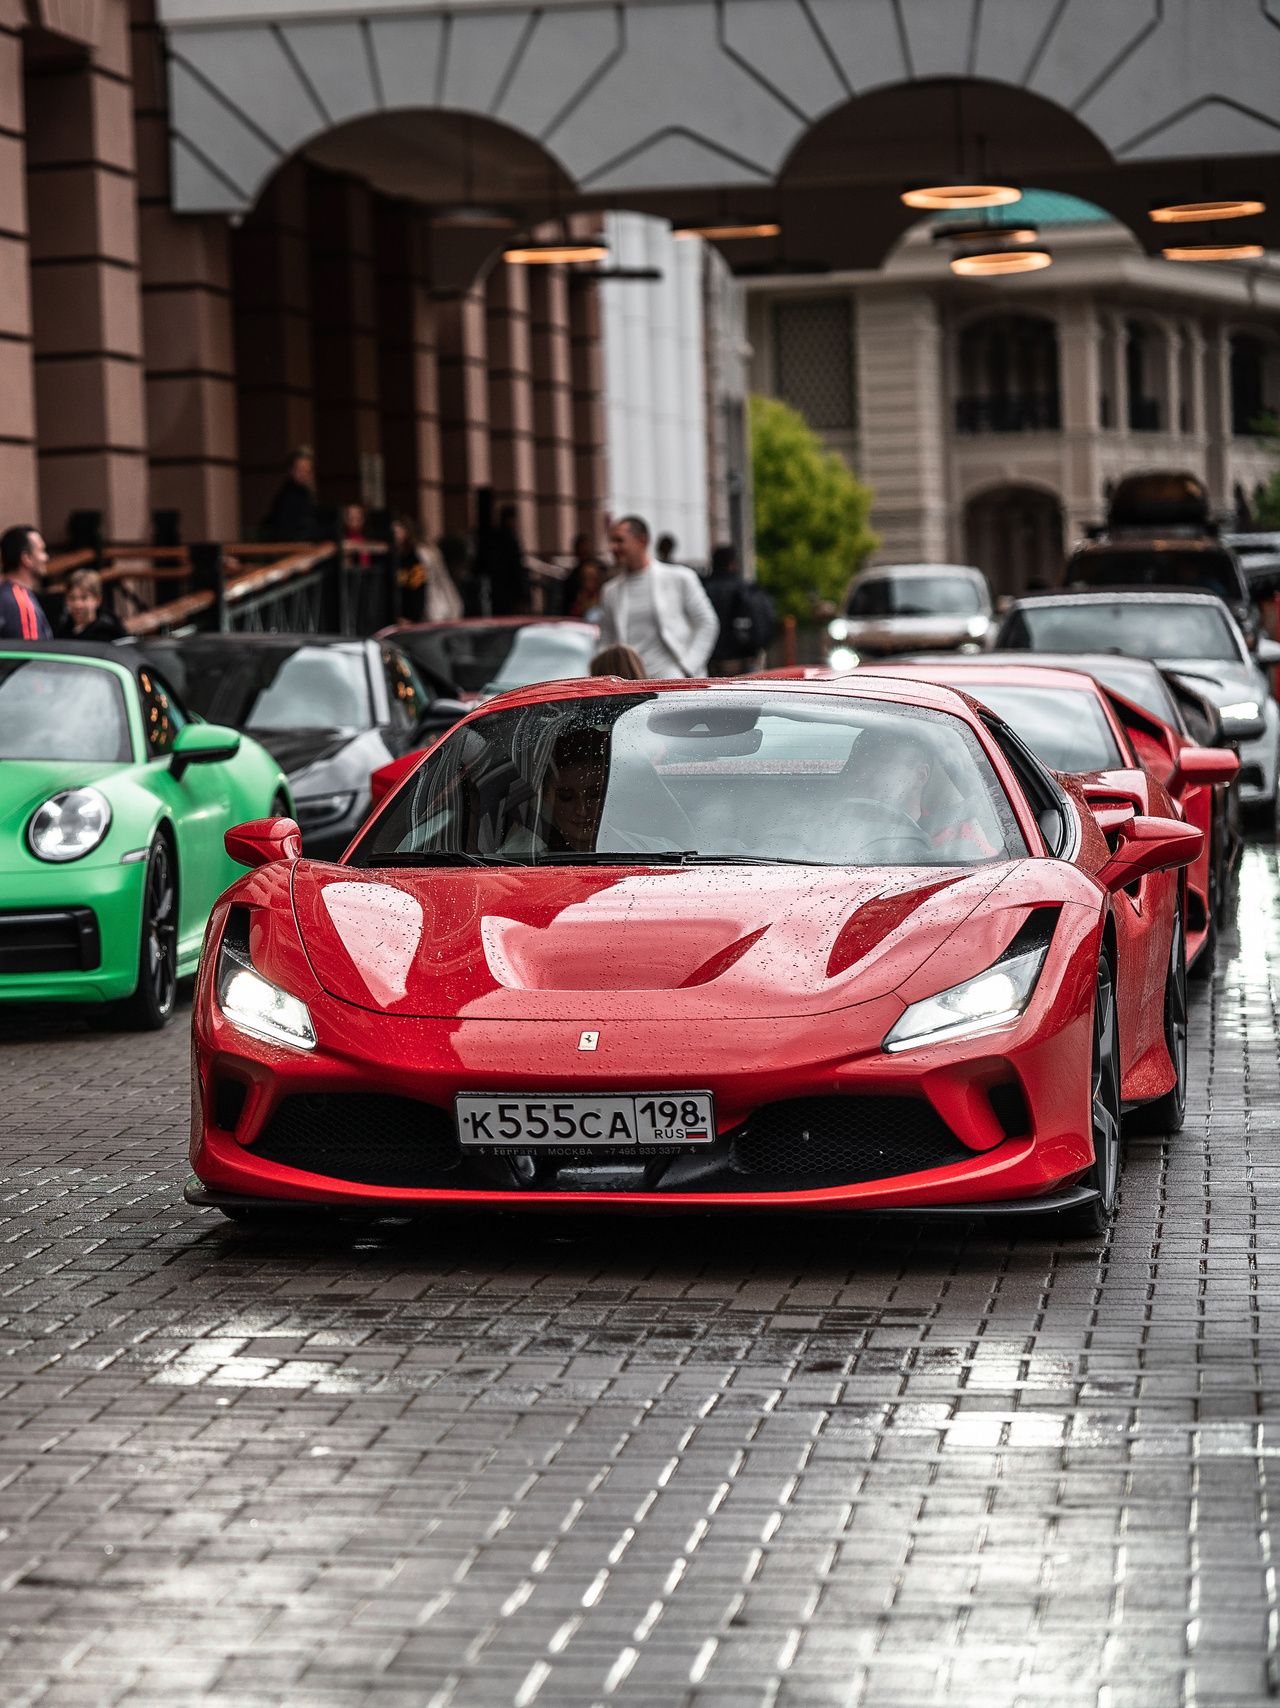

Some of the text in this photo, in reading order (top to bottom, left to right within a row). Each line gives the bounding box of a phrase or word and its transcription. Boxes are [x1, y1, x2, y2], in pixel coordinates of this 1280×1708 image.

[639, 1100, 700, 1128] 198
[654, 1128, 685, 1139] RUS
[493, 1147, 537, 1156] Ferrari
[618, 1147, 636, 1155] 495
[639, 1147, 656, 1155] 933
[659, 1146, 681, 1155] 3377
